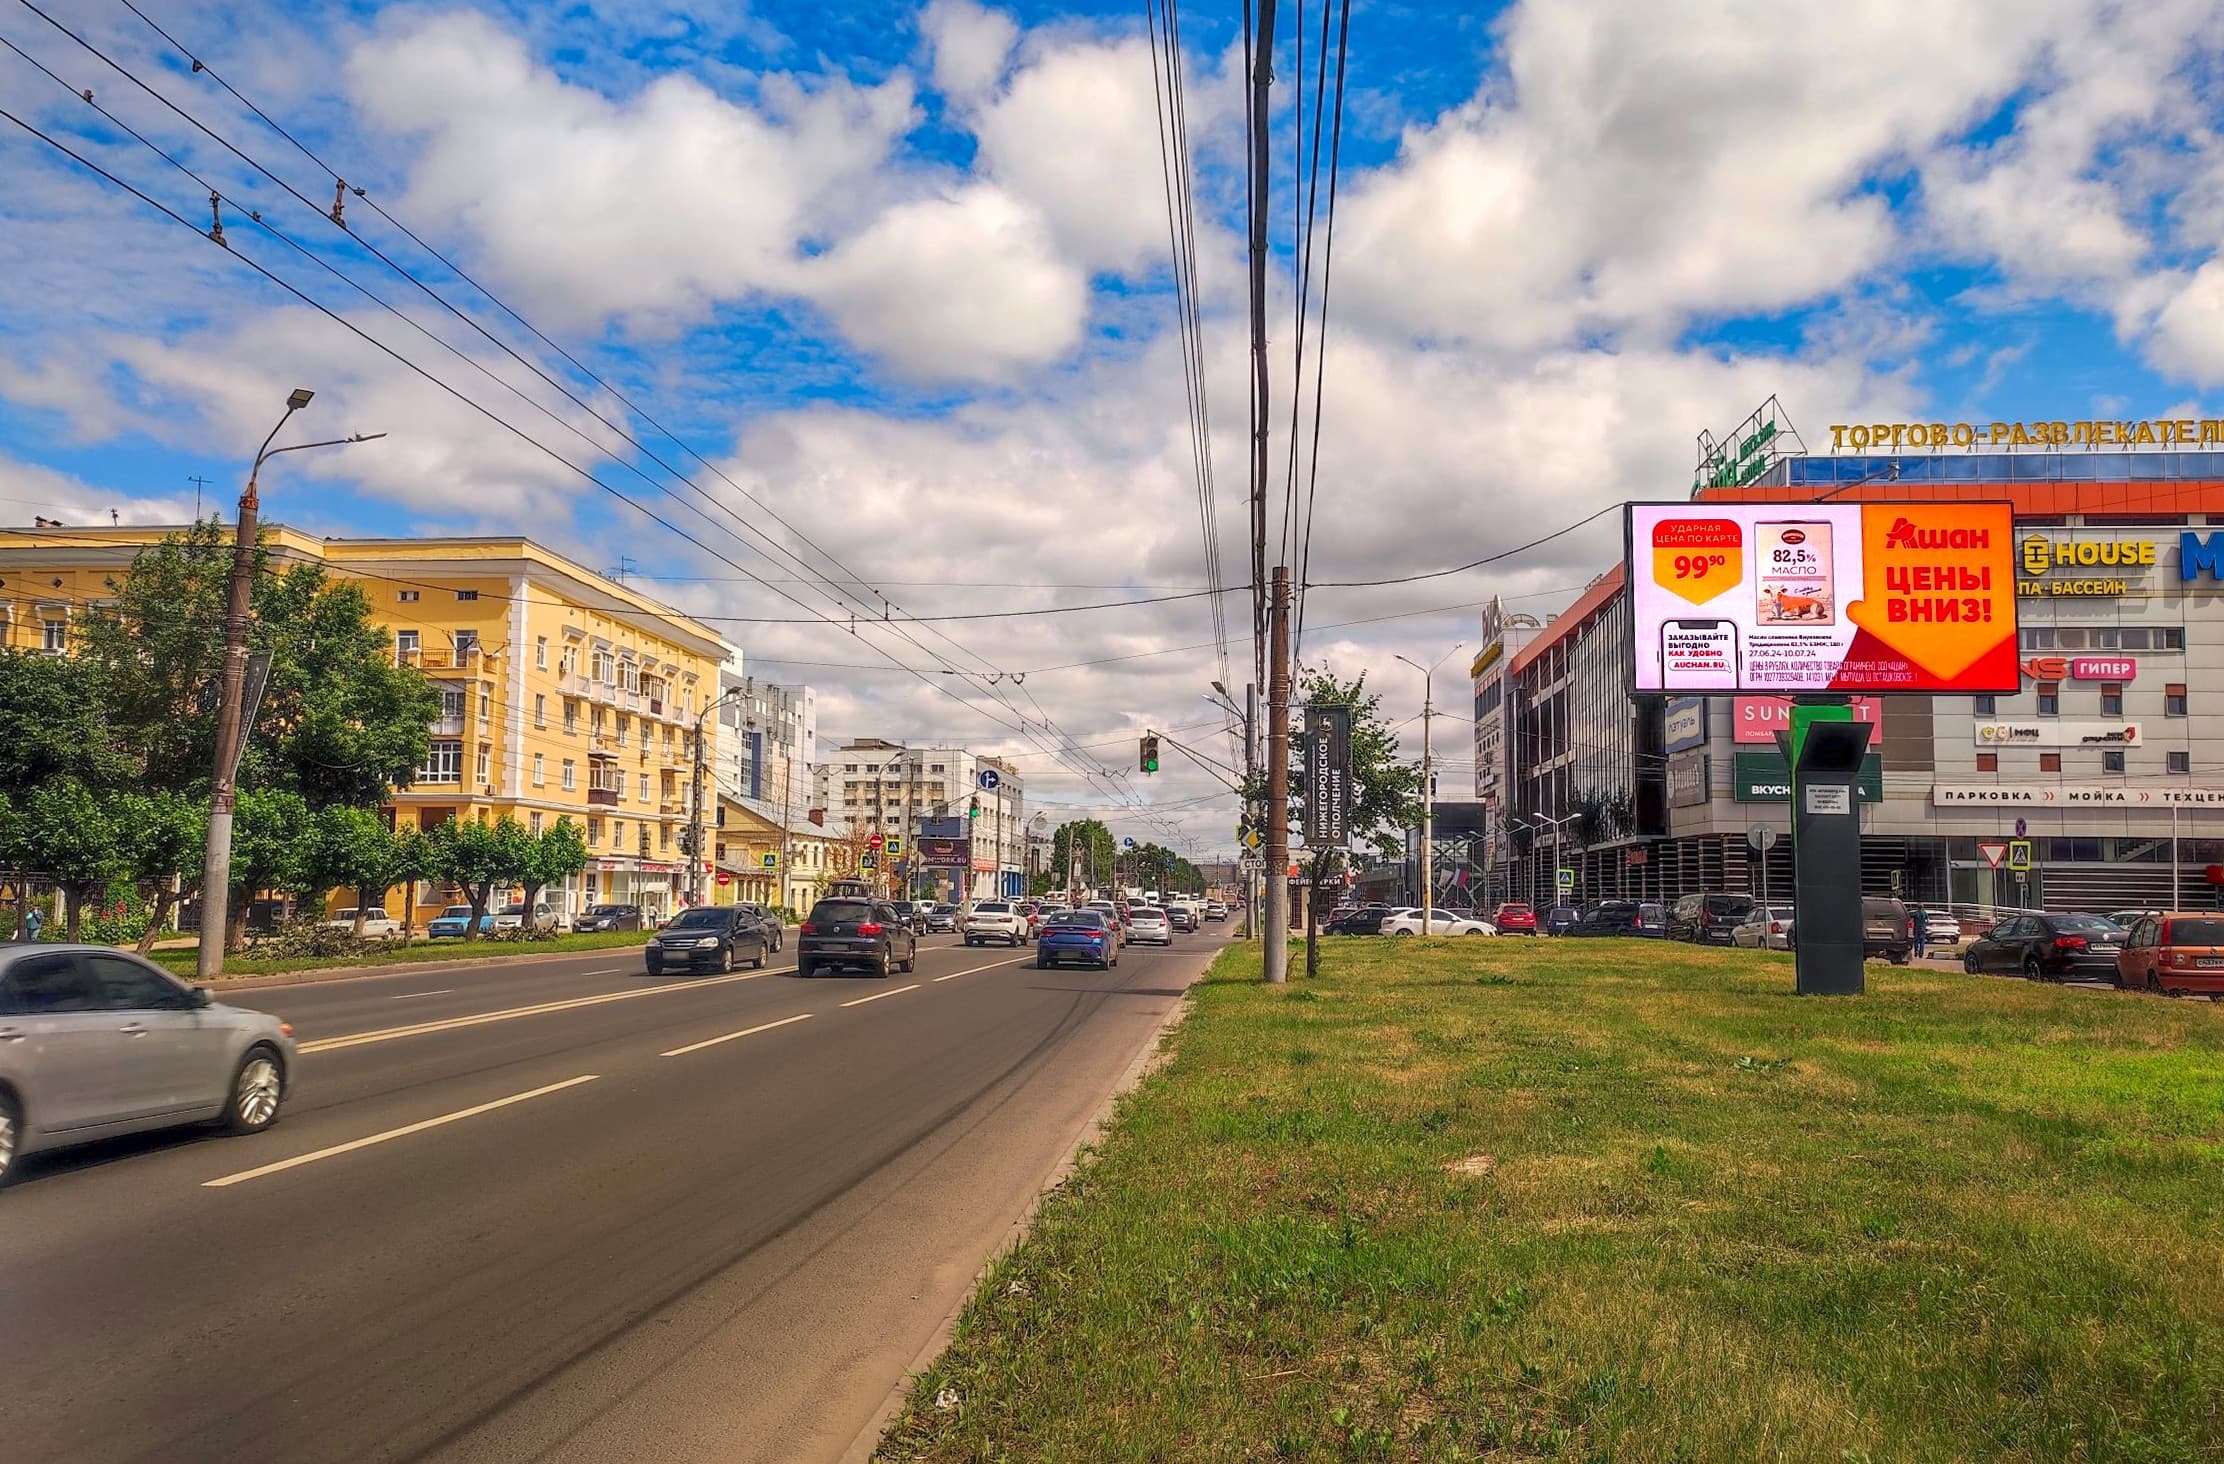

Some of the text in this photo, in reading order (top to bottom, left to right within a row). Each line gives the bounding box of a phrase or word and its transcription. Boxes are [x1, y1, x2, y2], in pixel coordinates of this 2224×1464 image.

[1830, 419, 2224, 448] ТОРГОВО-РАЗВЛЕКАТЕЛ
[1656, 534, 1738, 543] ЦЕНА ПО КАРТЕ
[1671, 524, 1721, 533] УДАРНАЯ
[1886, 517, 1989, 549] Ашан
[2056, 541, 2156, 565] HOUSE
[1772, 566, 1817, 575] МАСЛО
[1886, 566, 1991, 595] ЦЕНЫ
[2017, 578, 2127, 595] ПА БАССЕЙН
[1888, 598, 1992, 623] ВНИЗ!
[1668, 633, 1728, 641] ЗАКАЗЫВАЙТЕ
[2020, 657, 2068, 680] NS
[2080, 662, 2131, 674] ГИПЕР
[1319, 737, 1329, 839] НИЖЕГОРОДСКОЕ
[1751, 785, 1791, 795] ВКУСН
[1945, 791, 2032, 800] ПАРКОВКА
[2069, 789, 2125, 801] МОЙКА
[1331, 769, 1341, 839] ОПОЛЧЕНИЕ
